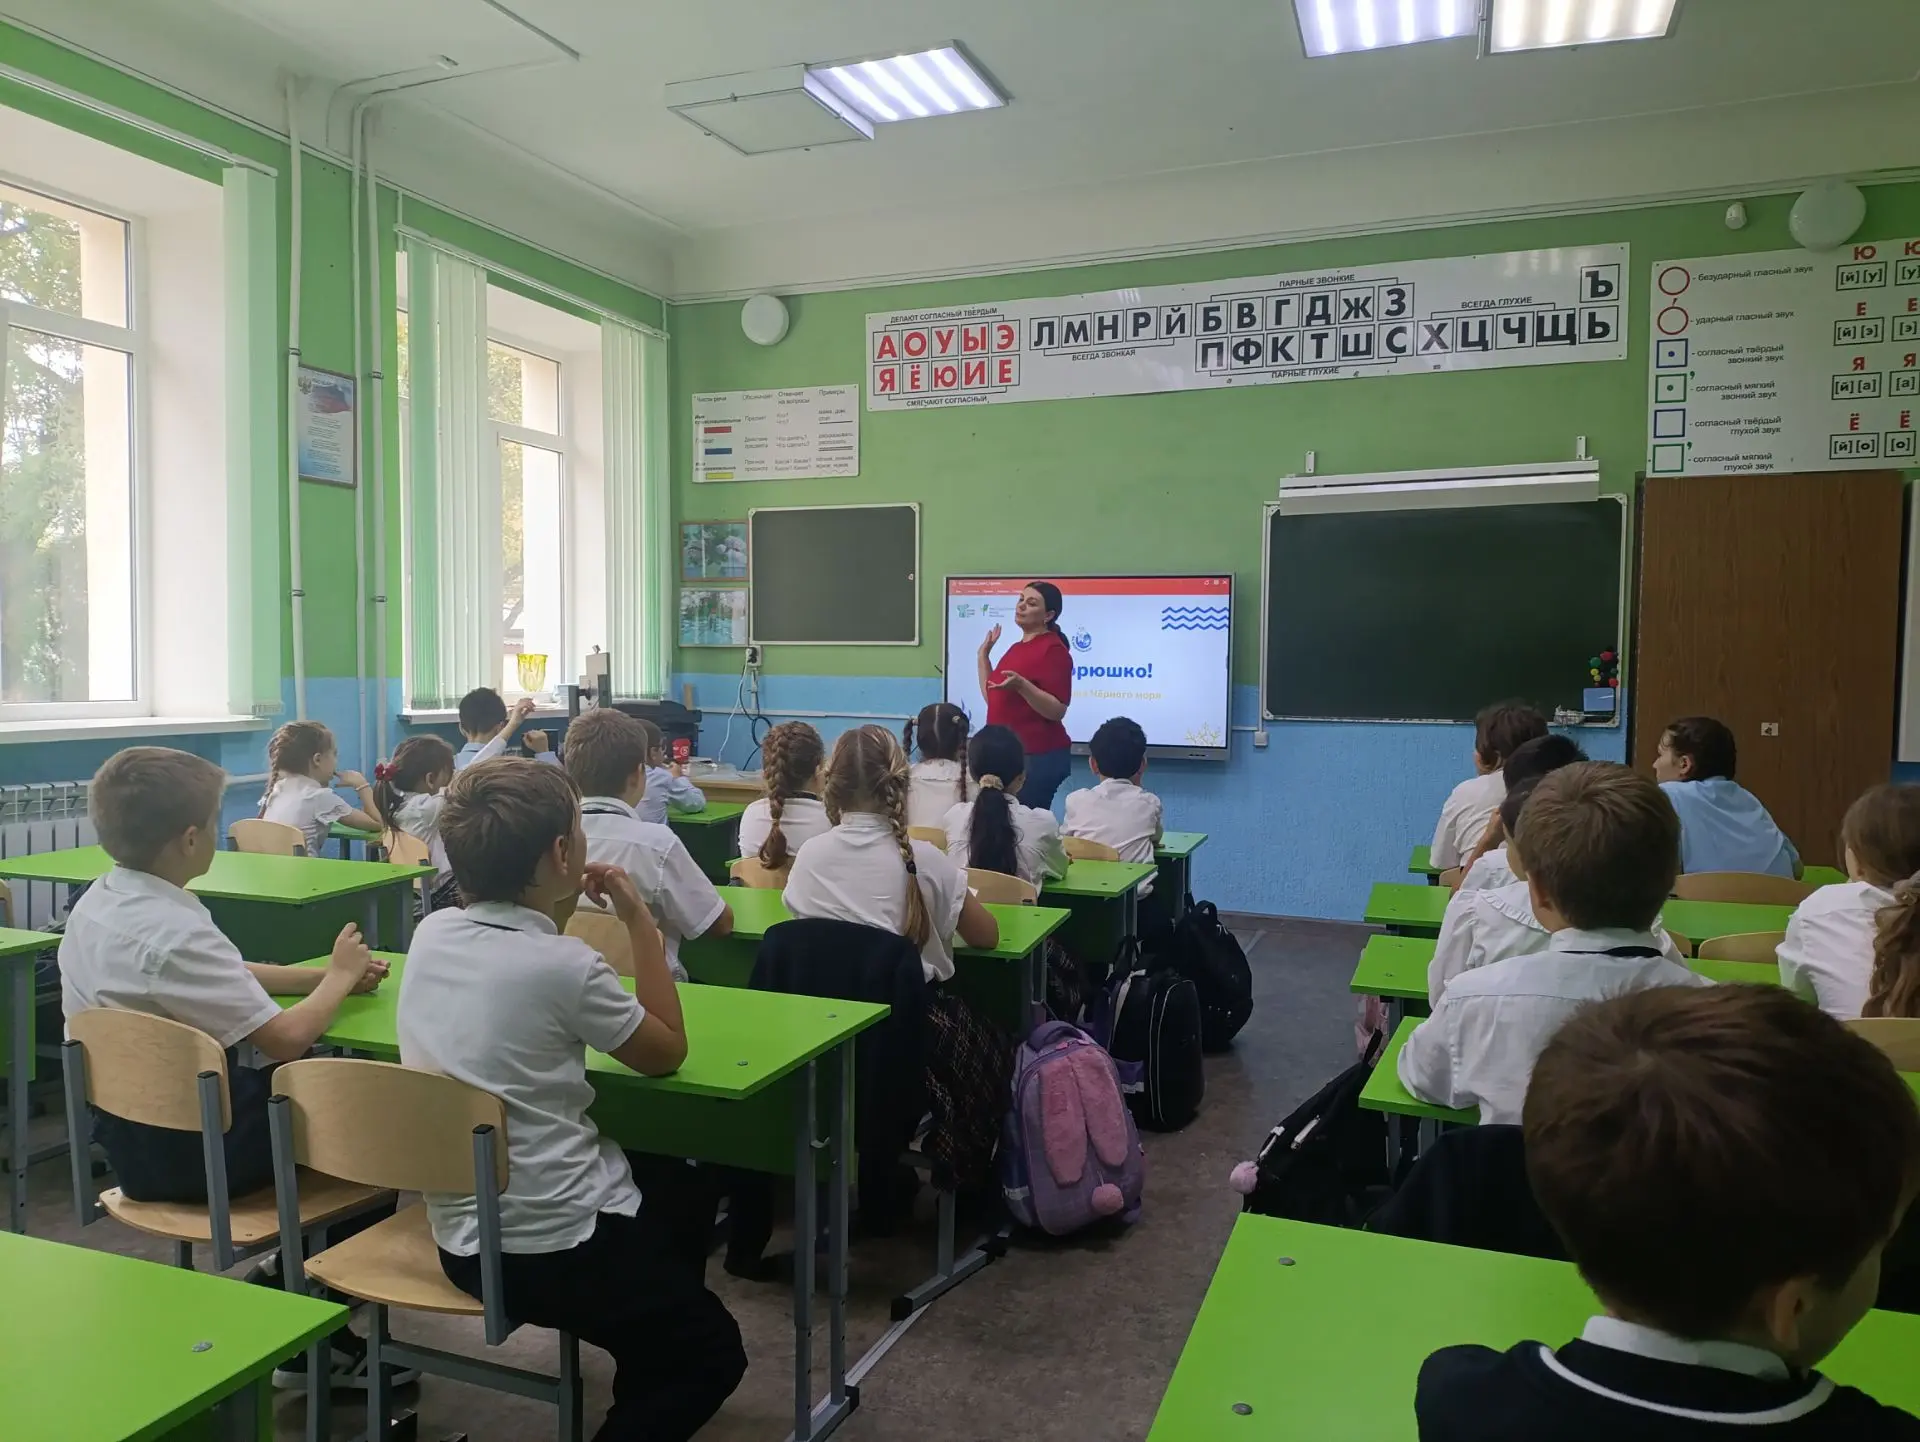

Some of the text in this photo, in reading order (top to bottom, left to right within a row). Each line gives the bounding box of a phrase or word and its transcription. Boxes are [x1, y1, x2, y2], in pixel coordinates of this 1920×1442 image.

[1854, 245, 1876, 260] Ю
[1279, 274, 1355, 287] ПАРНЫЕ ЗВОНКИЕ
[1698, 265, 1813, 282] безударный гласный звук
[1585, 271, 1614, 298] Ъ
[1461, 296, 1533, 309] ВСЕГДА ГЛУХИЕ
[1856, 302, 1867, 316] Е
[1908, 298, 1918, 312] Е
[890, 314, 919, 323] ДЕЛАЮТ
[920, 311, 962, 321] СОГЛАСНЫЙ
[1203, 288, 1406, 332] Б В Г Д Ж З
[1695, 311, 1795, 325] ударный гласный звук
[1034, 307, 1186, 347] Л М Н Р Й
[1420, 311, 1610, 351] Х Ц Ч Щ Ь
[877, 325, 1014, 359] А О У Ы Э
[1202, 326, 1407, 368] П Ф К Т Ш С
[1072, 349, 1135, 361] ВСЕГДА ЗВОНКАЯ
[1697, 344, 1784, 357] согласный твёрдый
[1728, 355, 1784, 364] звонкий звук
[1853, 356, 1865, 371] Я
[1904, 353, 1916, 367] Я
[879, 359, 1012, 392] Я Ё Ю И Е
[1271, 367, 1340, 378] ПАРНЫЕ ГЛУХИЕ
[1696, 380, 1775, 392] согласный мягкий
[906, 395, 987, 407] СМЯГЧАЮТ СОГЛАСНЫЙ
[1721, 391, 1777, 400] звонкий звук
[1694, 416, 1782, 427] согласный твёрдый
[1730, 427, 1781, 436] глухой звук
[1693, 452, 1772, 463] согласный мягкий
[1724, 463, 1774, 472] глухой звук
[1072, 663, 1152, 680] рюшко!
